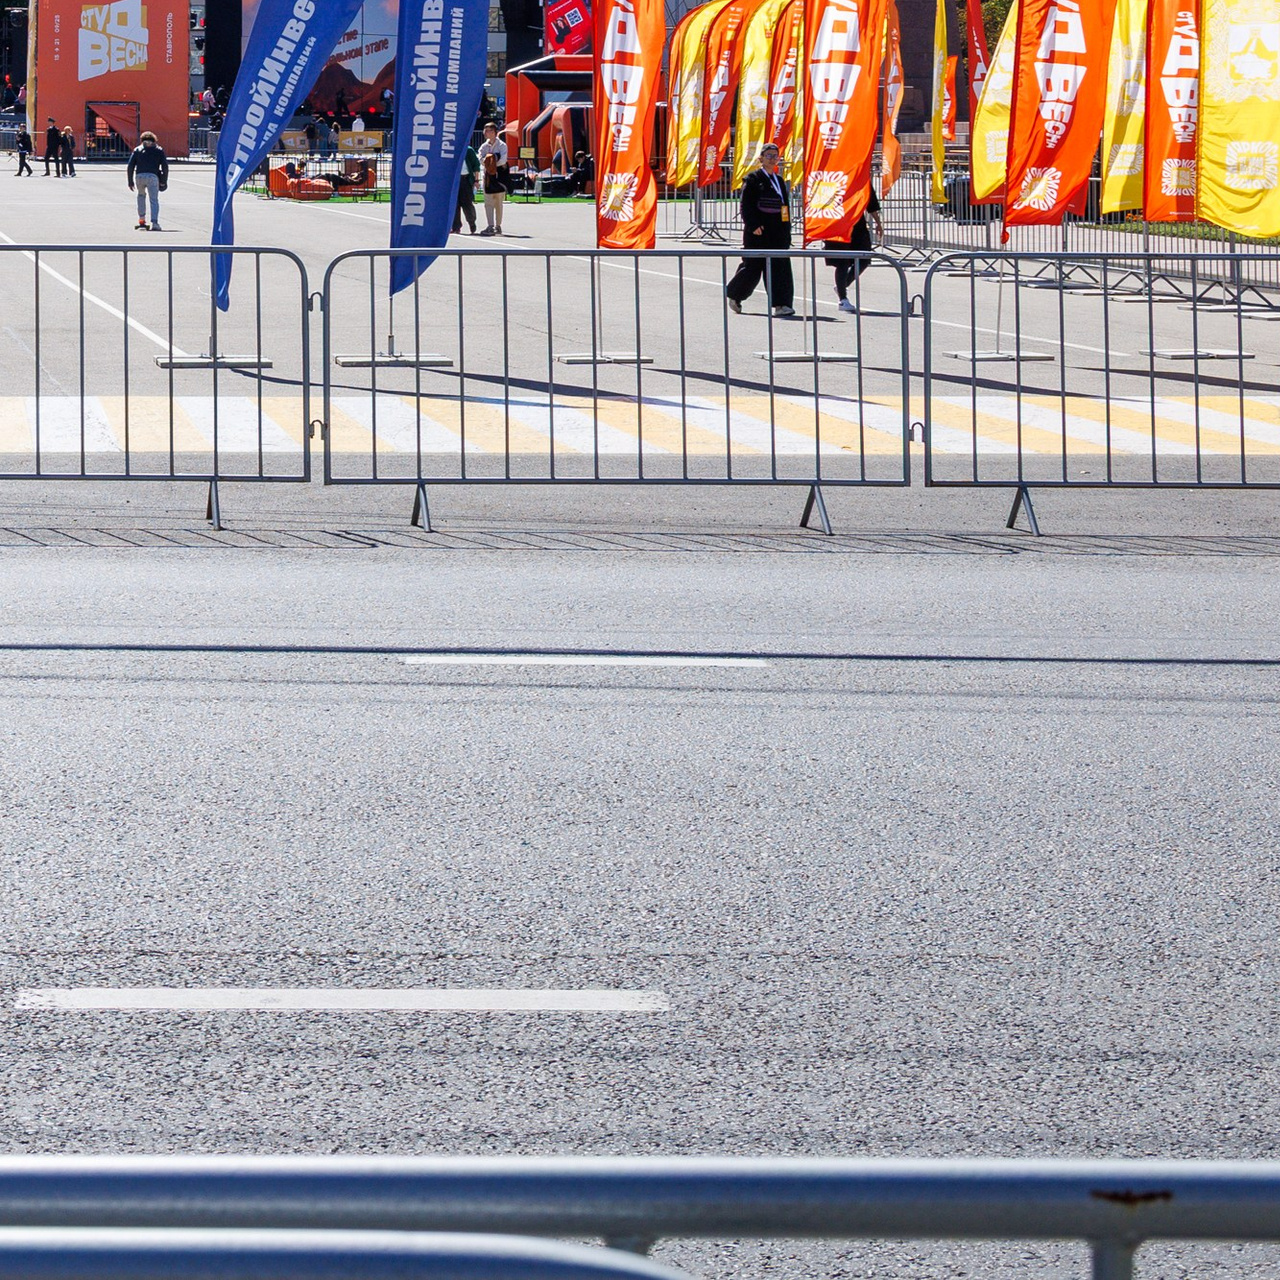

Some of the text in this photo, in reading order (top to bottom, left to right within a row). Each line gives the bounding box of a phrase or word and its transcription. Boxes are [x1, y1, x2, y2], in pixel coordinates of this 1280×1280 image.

[78, 27, 148, 82] ВЕСНА
[275, 36, 317, 117] КОМПАНИЙ
[441, 7, 464, 158] ГРУППА КОМПАНИЙ
[1161, 11, 1199, 76] СТУД
[600, 63, 644, 152] ВЕСНА
[809, 63, 861, 149] ВЕСНА
[1034, 62, 1087, 148] ВЕСНА
[1160, 77, 1198, 143] ВЕСНА
